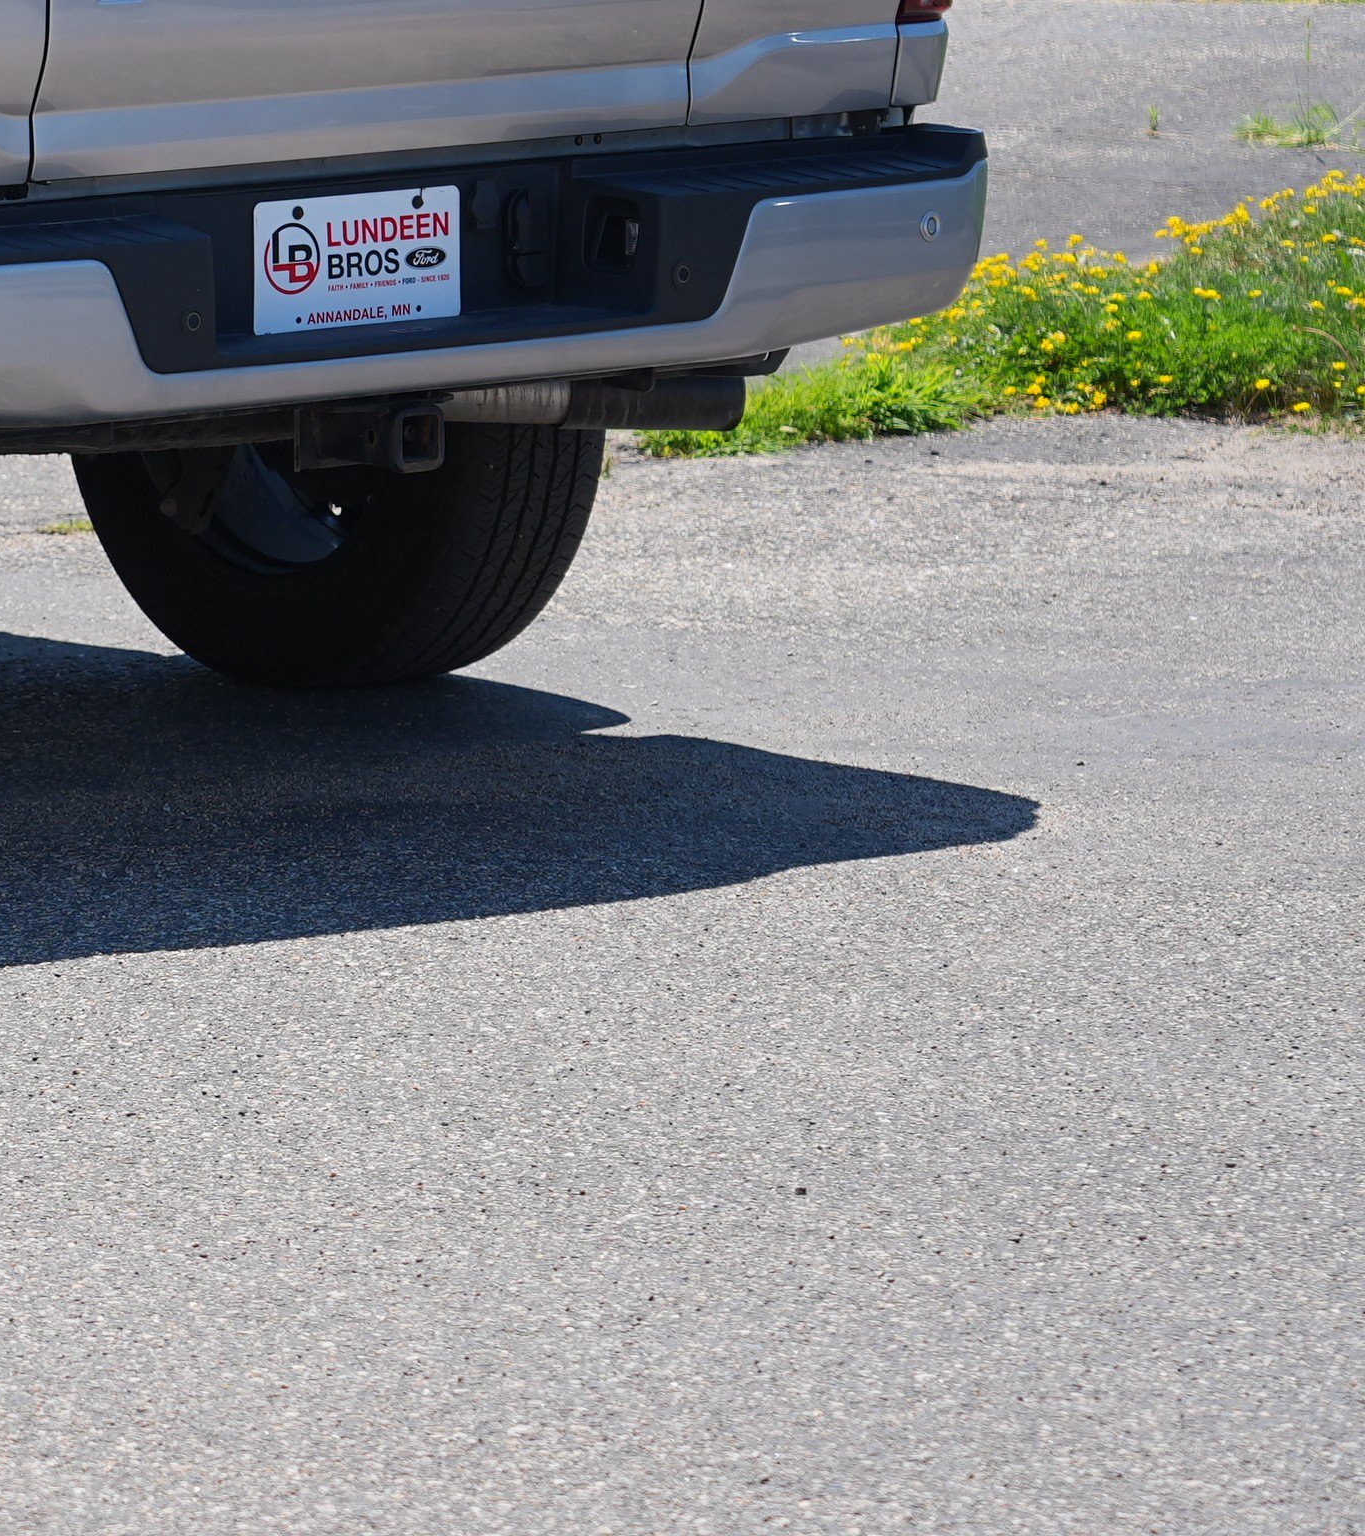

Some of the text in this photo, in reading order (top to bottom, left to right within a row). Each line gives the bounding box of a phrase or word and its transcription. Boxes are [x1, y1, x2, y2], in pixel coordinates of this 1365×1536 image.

[326, 211, 449, 247] LUNDEEN
[327, 247, 400, 280] BROS
[328, 284, 344, 292] FAITH
[350, 282, 369, 290] FAMILY
[374, 279, 397, 287] FRIENDS
[421, 275, 436, 283] SINCE
[307, 303, 411, 325] ANNANDALE, MN
